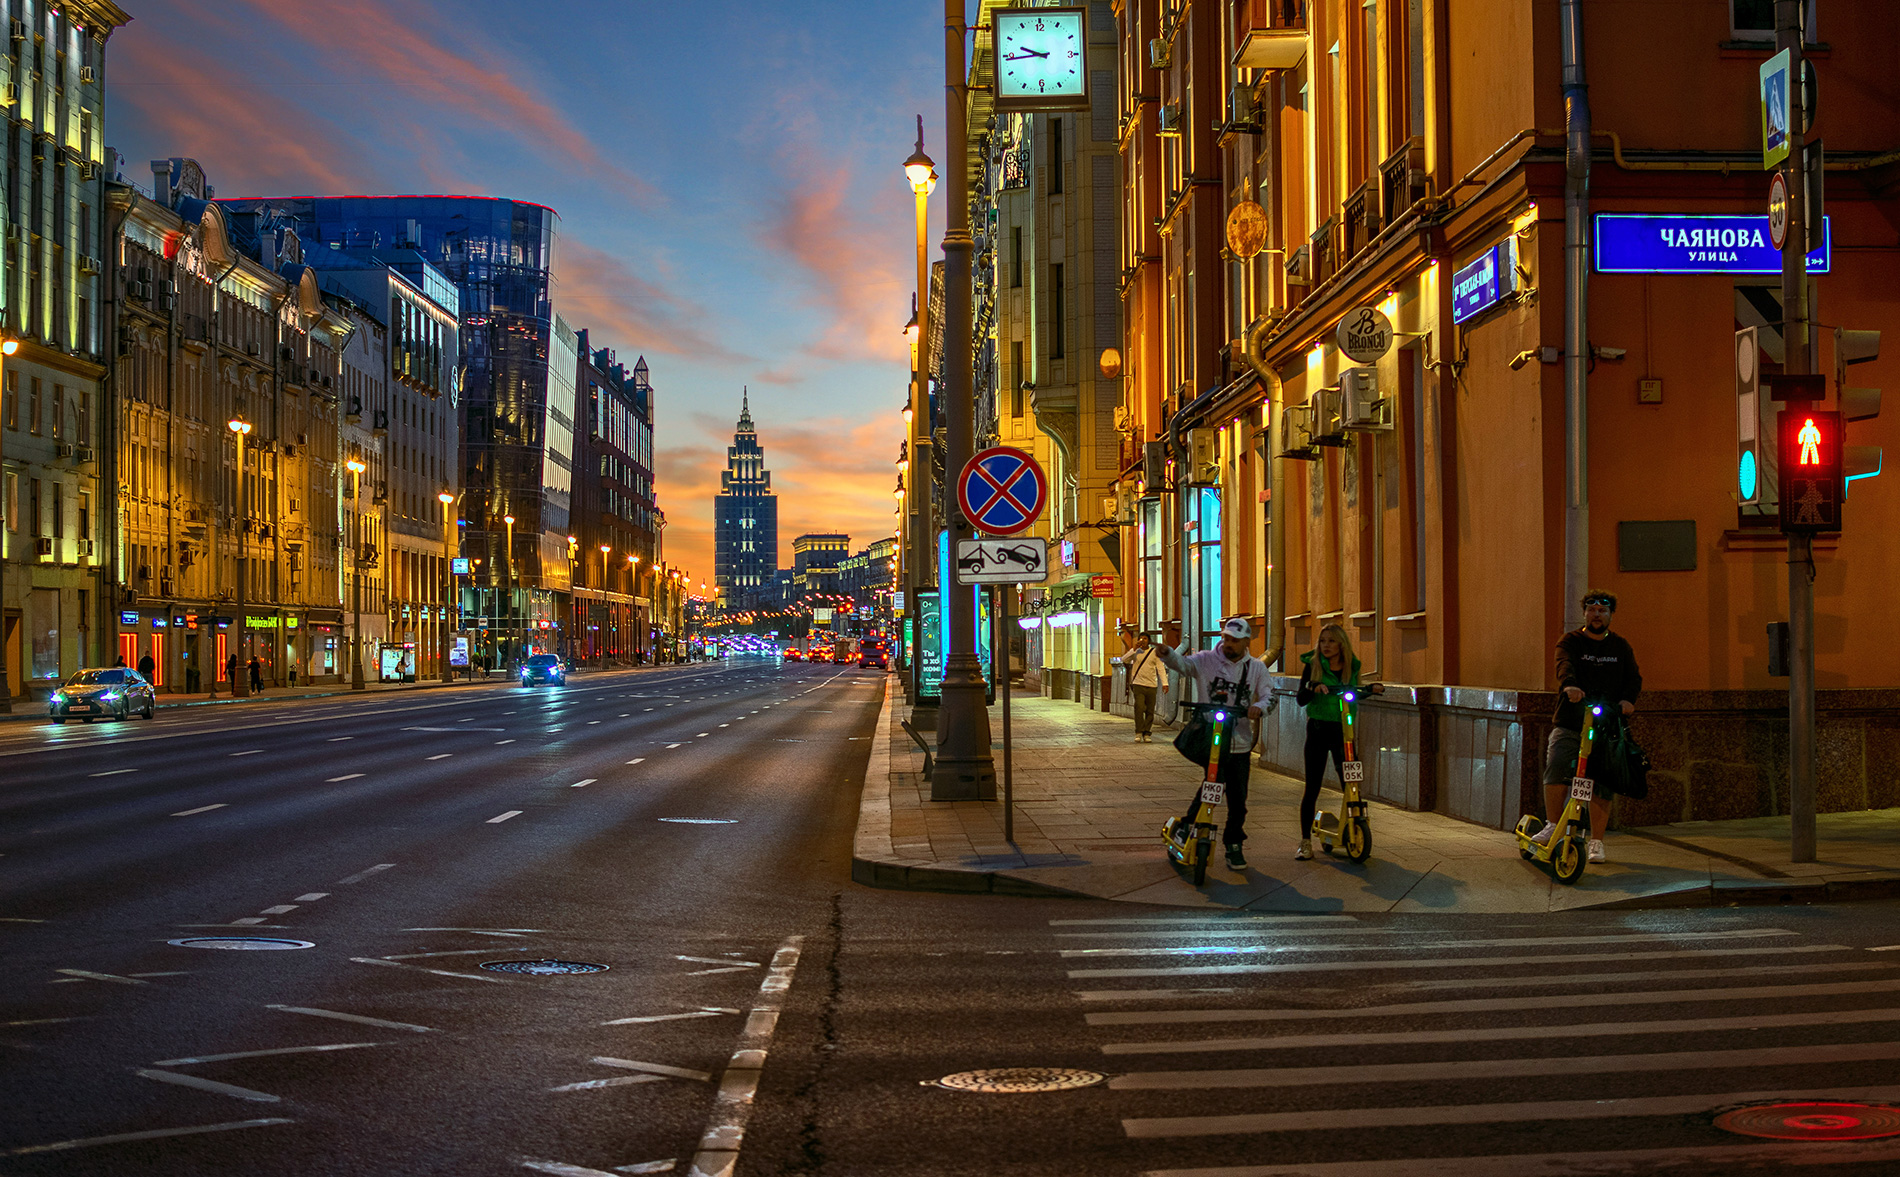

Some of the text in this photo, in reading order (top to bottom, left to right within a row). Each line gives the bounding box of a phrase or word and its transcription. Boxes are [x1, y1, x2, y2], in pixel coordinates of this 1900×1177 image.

[1035, 23, 1045, 31] 12
[1039, 79, 1045, 87] 6
[1660, 228, 1765, 248] ЧАЯНОВА
[1689, 252, 1738, 263] УЛИЦА
[1347, 330, 1385, 350] BRONCO
